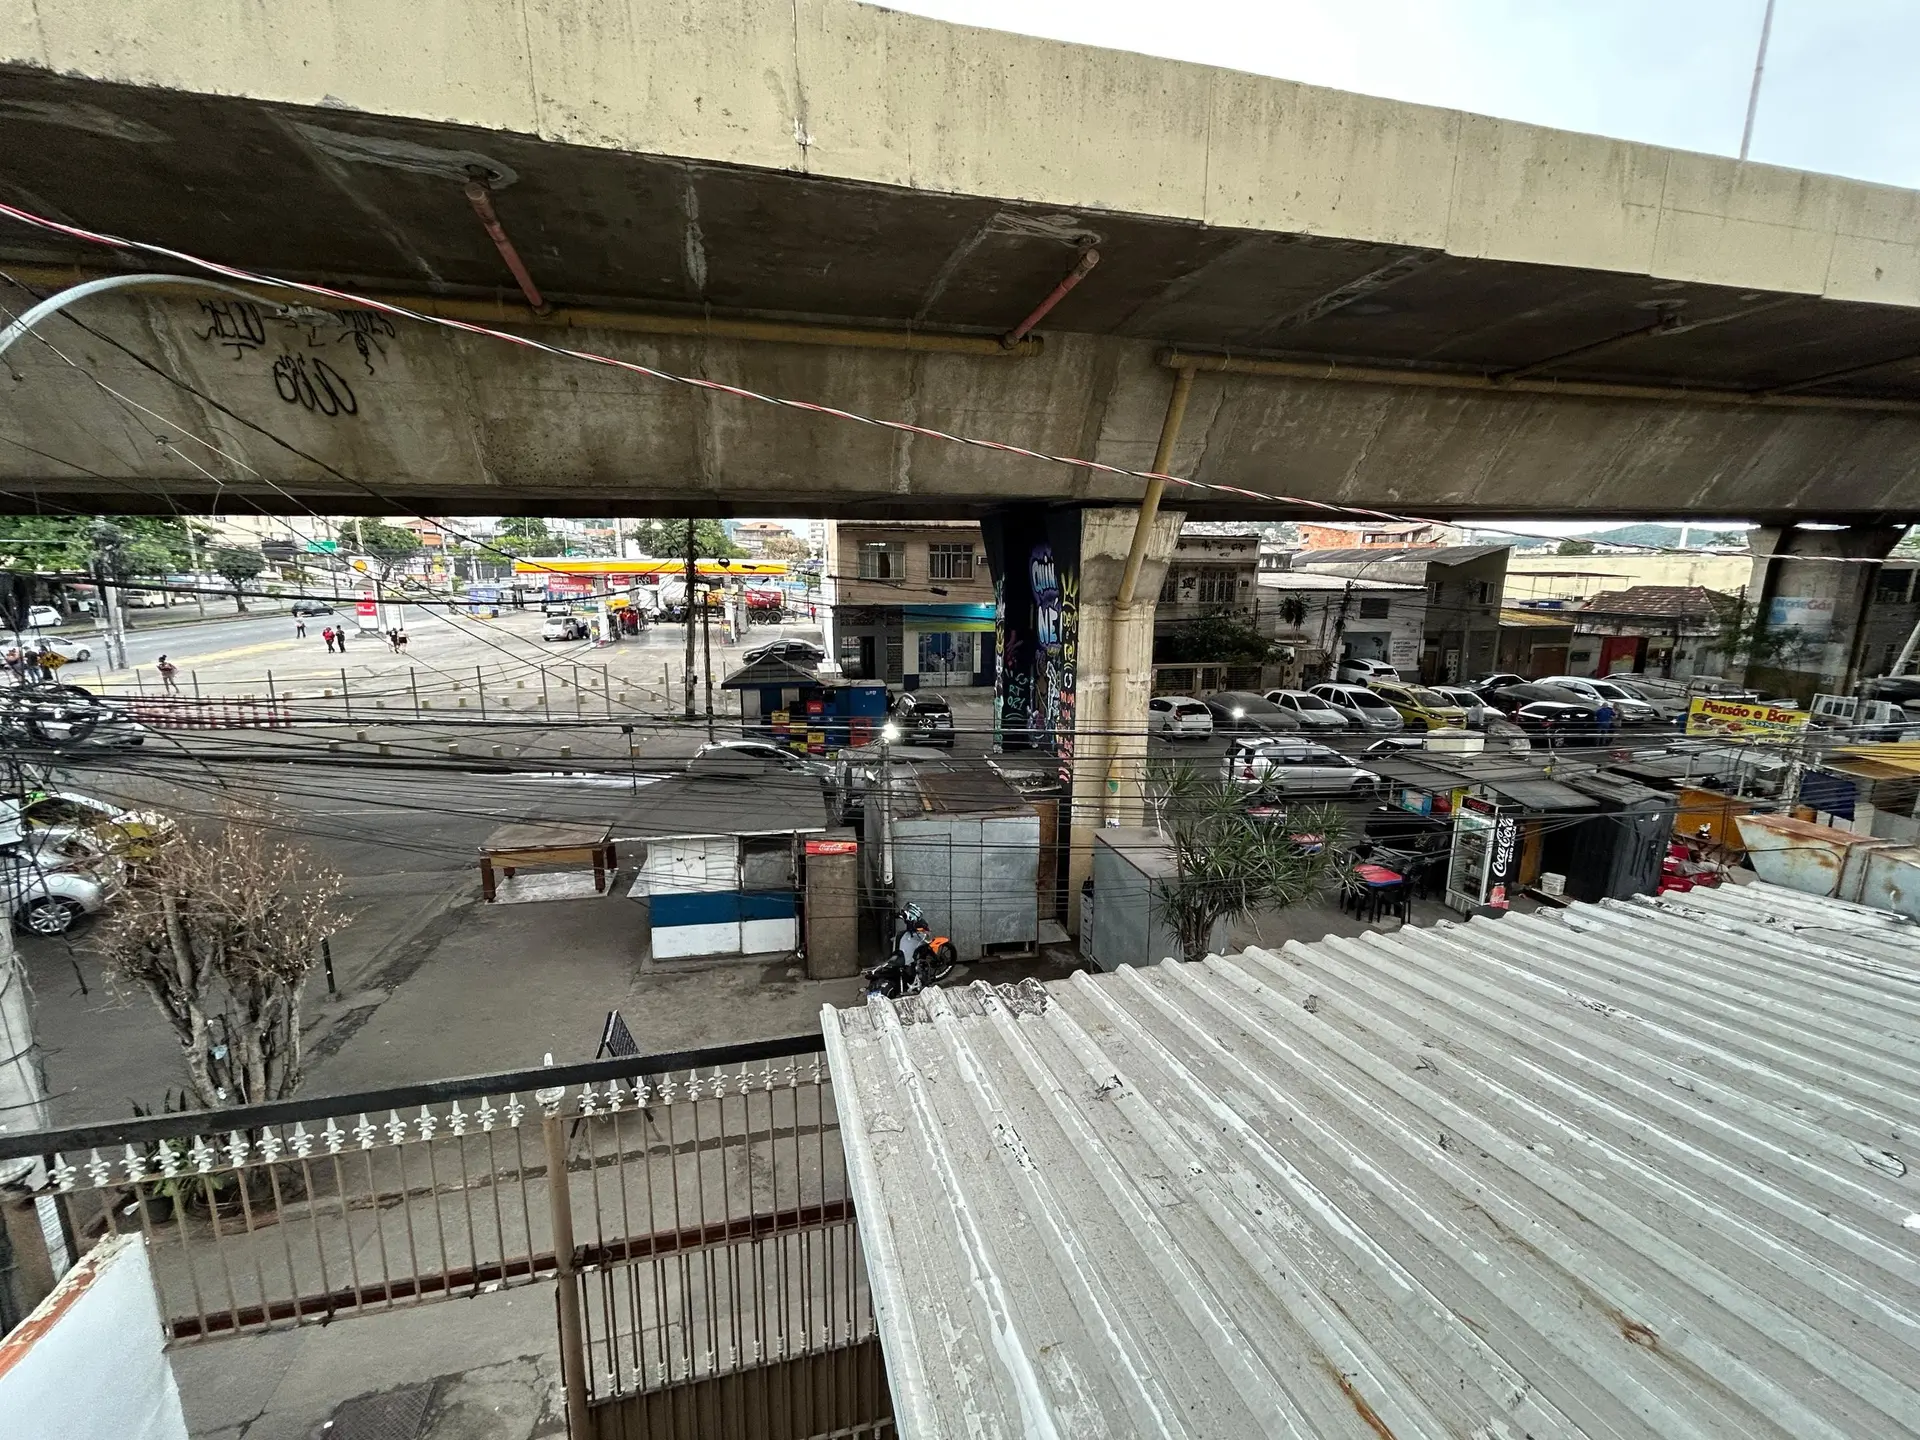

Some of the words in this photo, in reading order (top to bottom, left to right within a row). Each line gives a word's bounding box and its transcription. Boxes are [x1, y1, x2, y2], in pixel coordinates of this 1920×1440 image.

[1702, 700, 1750, 718] Pensão
[1753, 710, 1763, 719] e
[1766, 708, 1796, 724] Bar
[1491, 813, 1514, 878] Coca-Cola
